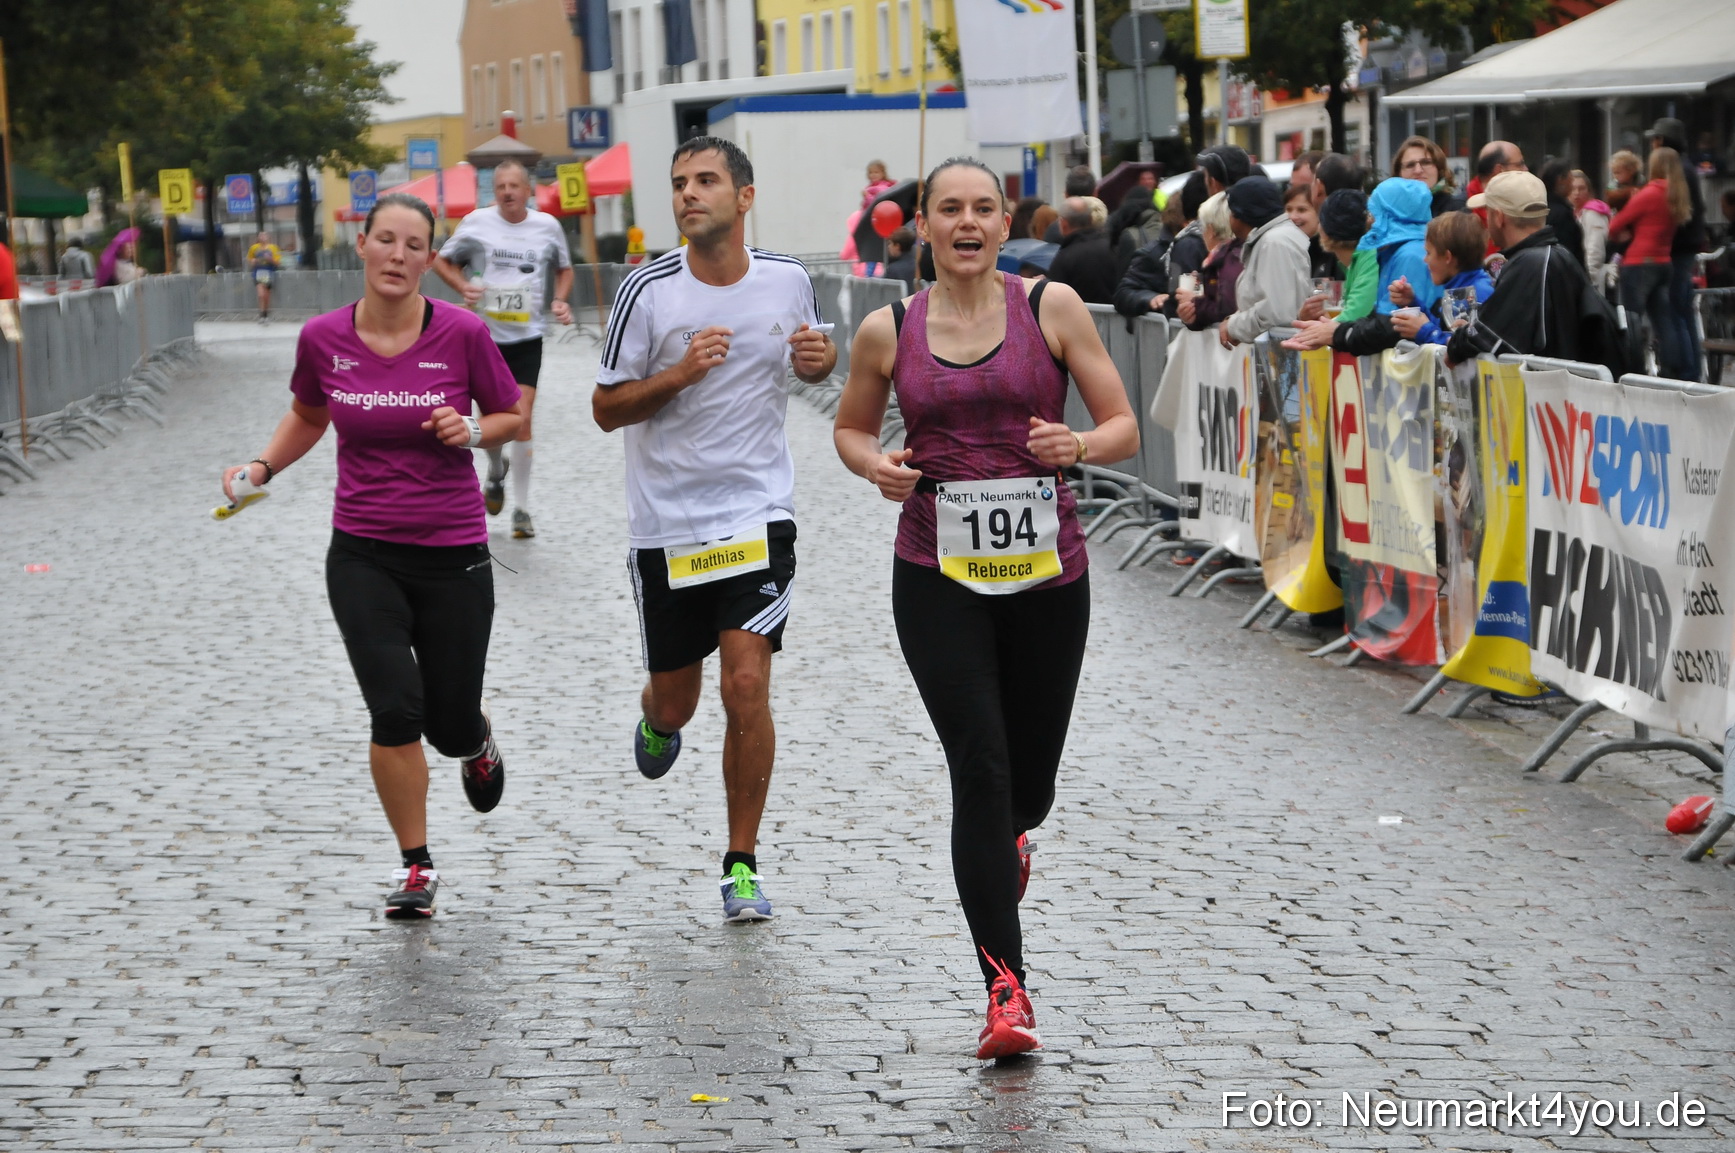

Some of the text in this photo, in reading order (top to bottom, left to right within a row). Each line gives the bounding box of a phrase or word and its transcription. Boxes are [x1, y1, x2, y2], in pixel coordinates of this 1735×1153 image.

[168, 183, 183, 204] D
[566, 177, 580, 197] D
[491, 249, 524, 259] Allianz
[495, 294, 522, 310] 173
[939, 489, 1037, 503] PARTL Neumarkt
[962, 507, 1038, 550] 194
[691, 549, 745, 571] Matthias
[968, 562, 1032, 578] Rebecca
[1672, 650, 1717, 685] 92318
